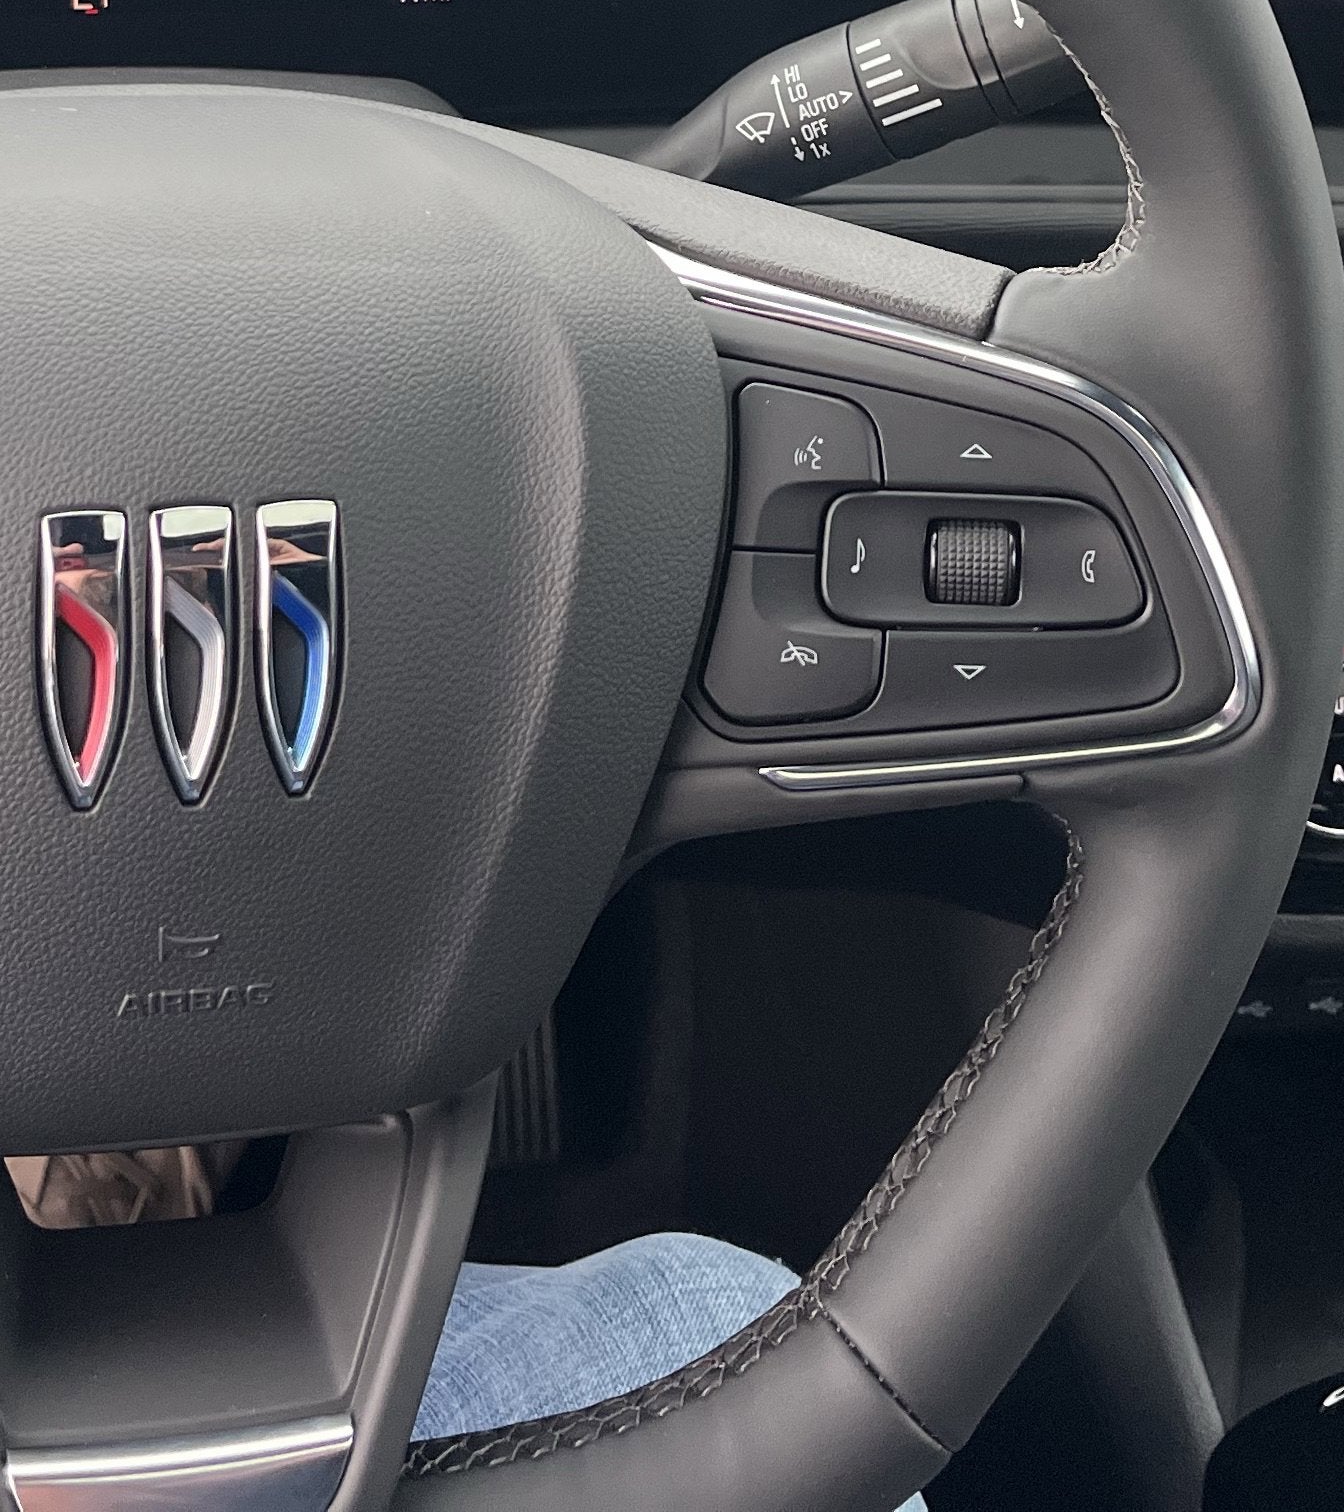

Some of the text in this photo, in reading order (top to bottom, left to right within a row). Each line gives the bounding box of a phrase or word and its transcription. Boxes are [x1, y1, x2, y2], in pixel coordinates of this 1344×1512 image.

[783, 63, 802, 84] HI
[789, 82, 808, 103] LO
[797, 94, 840, 121] AUTO
[801, 118, 829, 142] OFF
